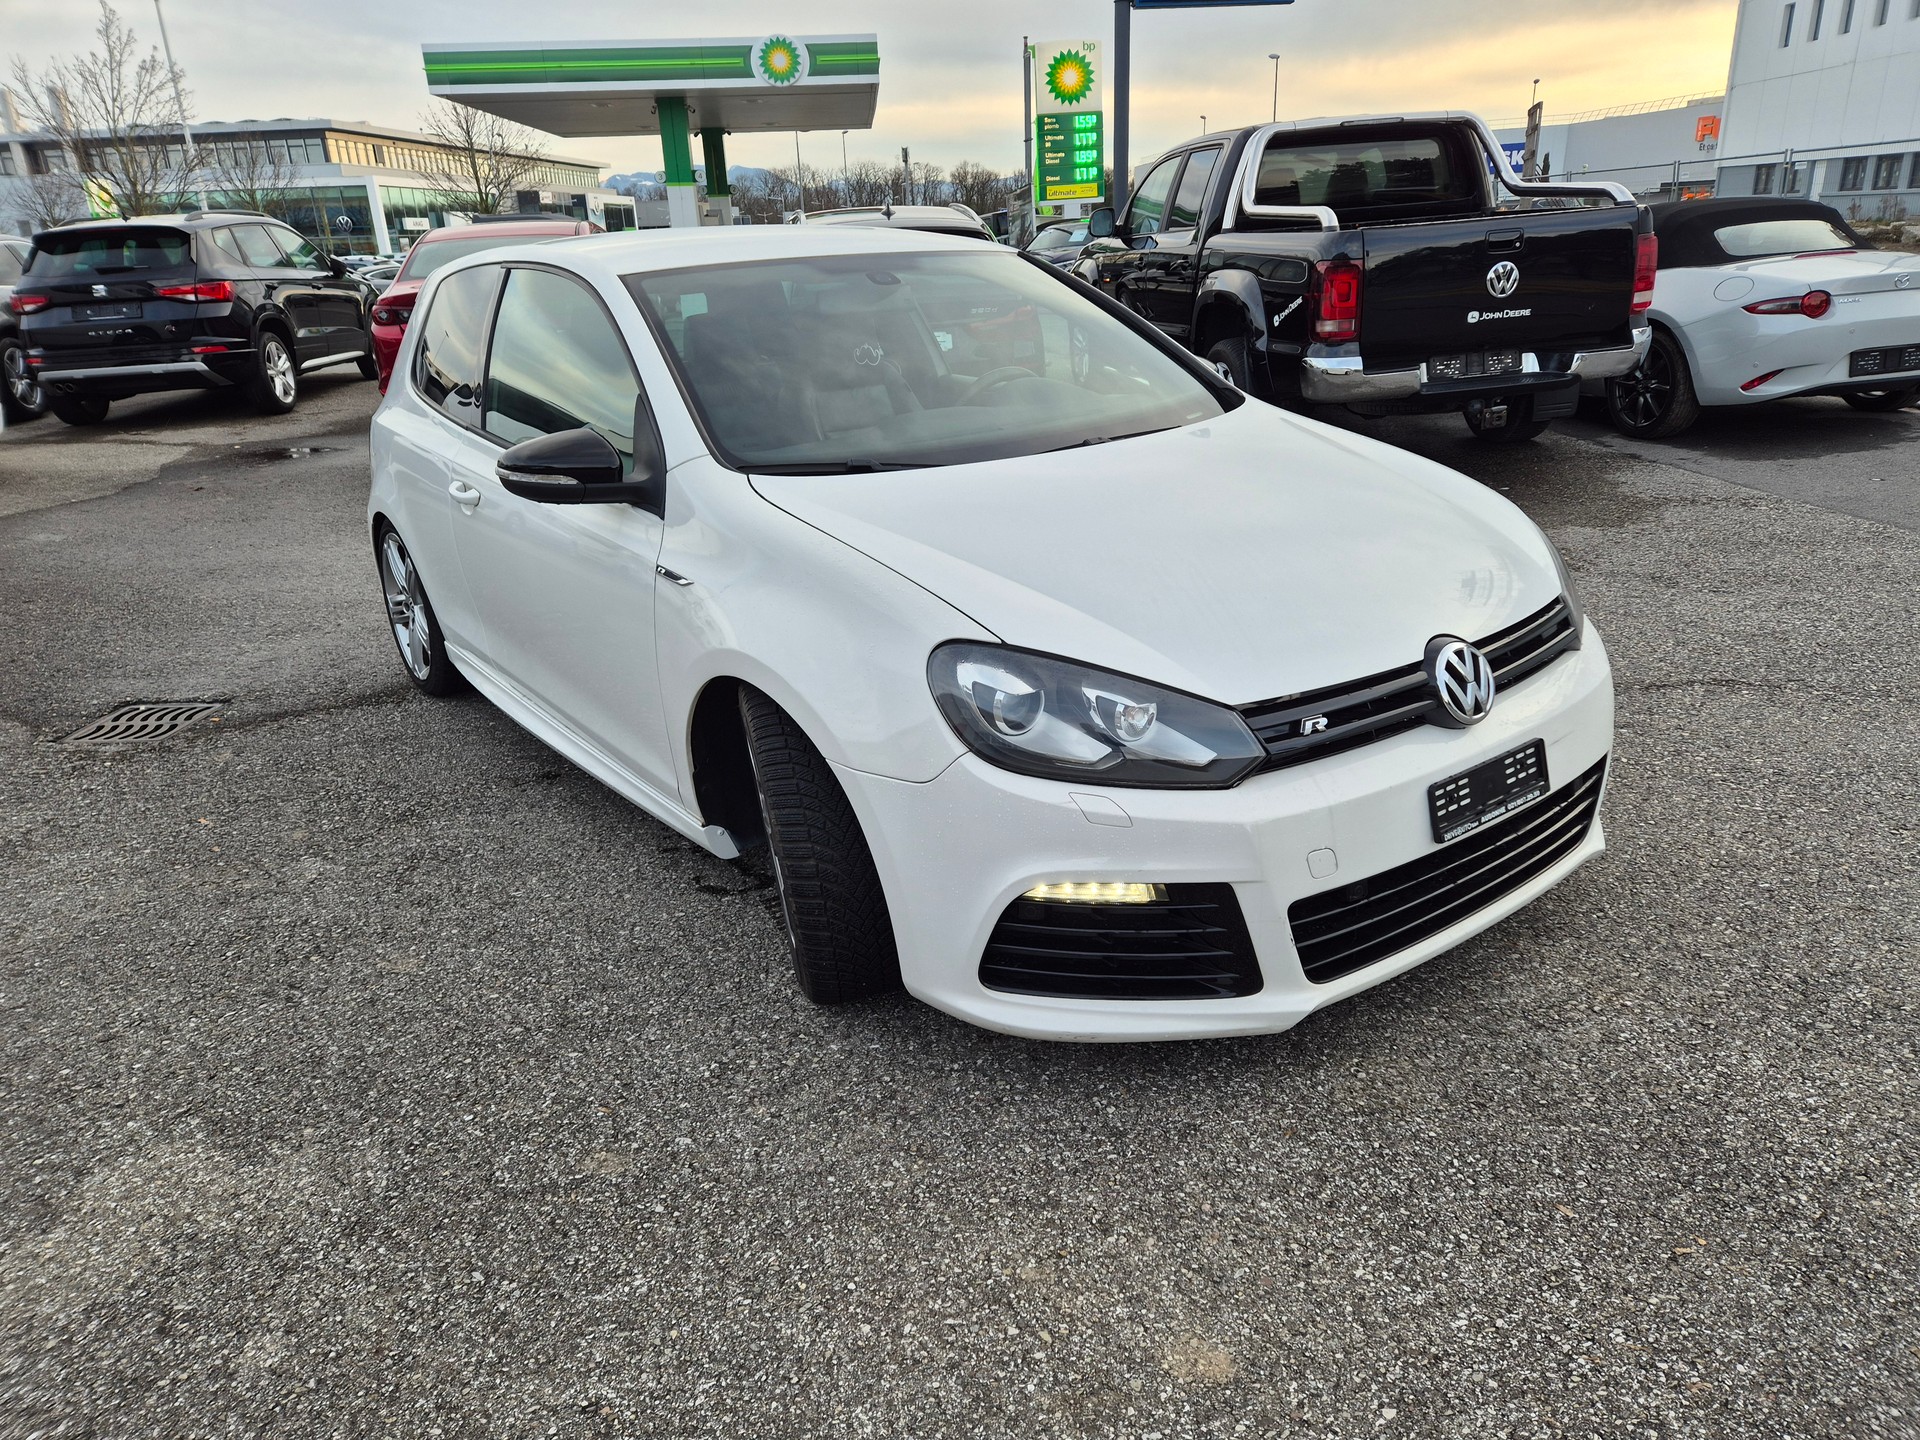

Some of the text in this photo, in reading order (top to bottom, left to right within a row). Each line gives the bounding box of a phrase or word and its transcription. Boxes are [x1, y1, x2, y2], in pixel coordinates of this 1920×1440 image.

[1083, 41, 1095, 53] bp
[1480, 309, 1531, 320] JOHN DEERE
[1300, 714, 1328, 736] R
